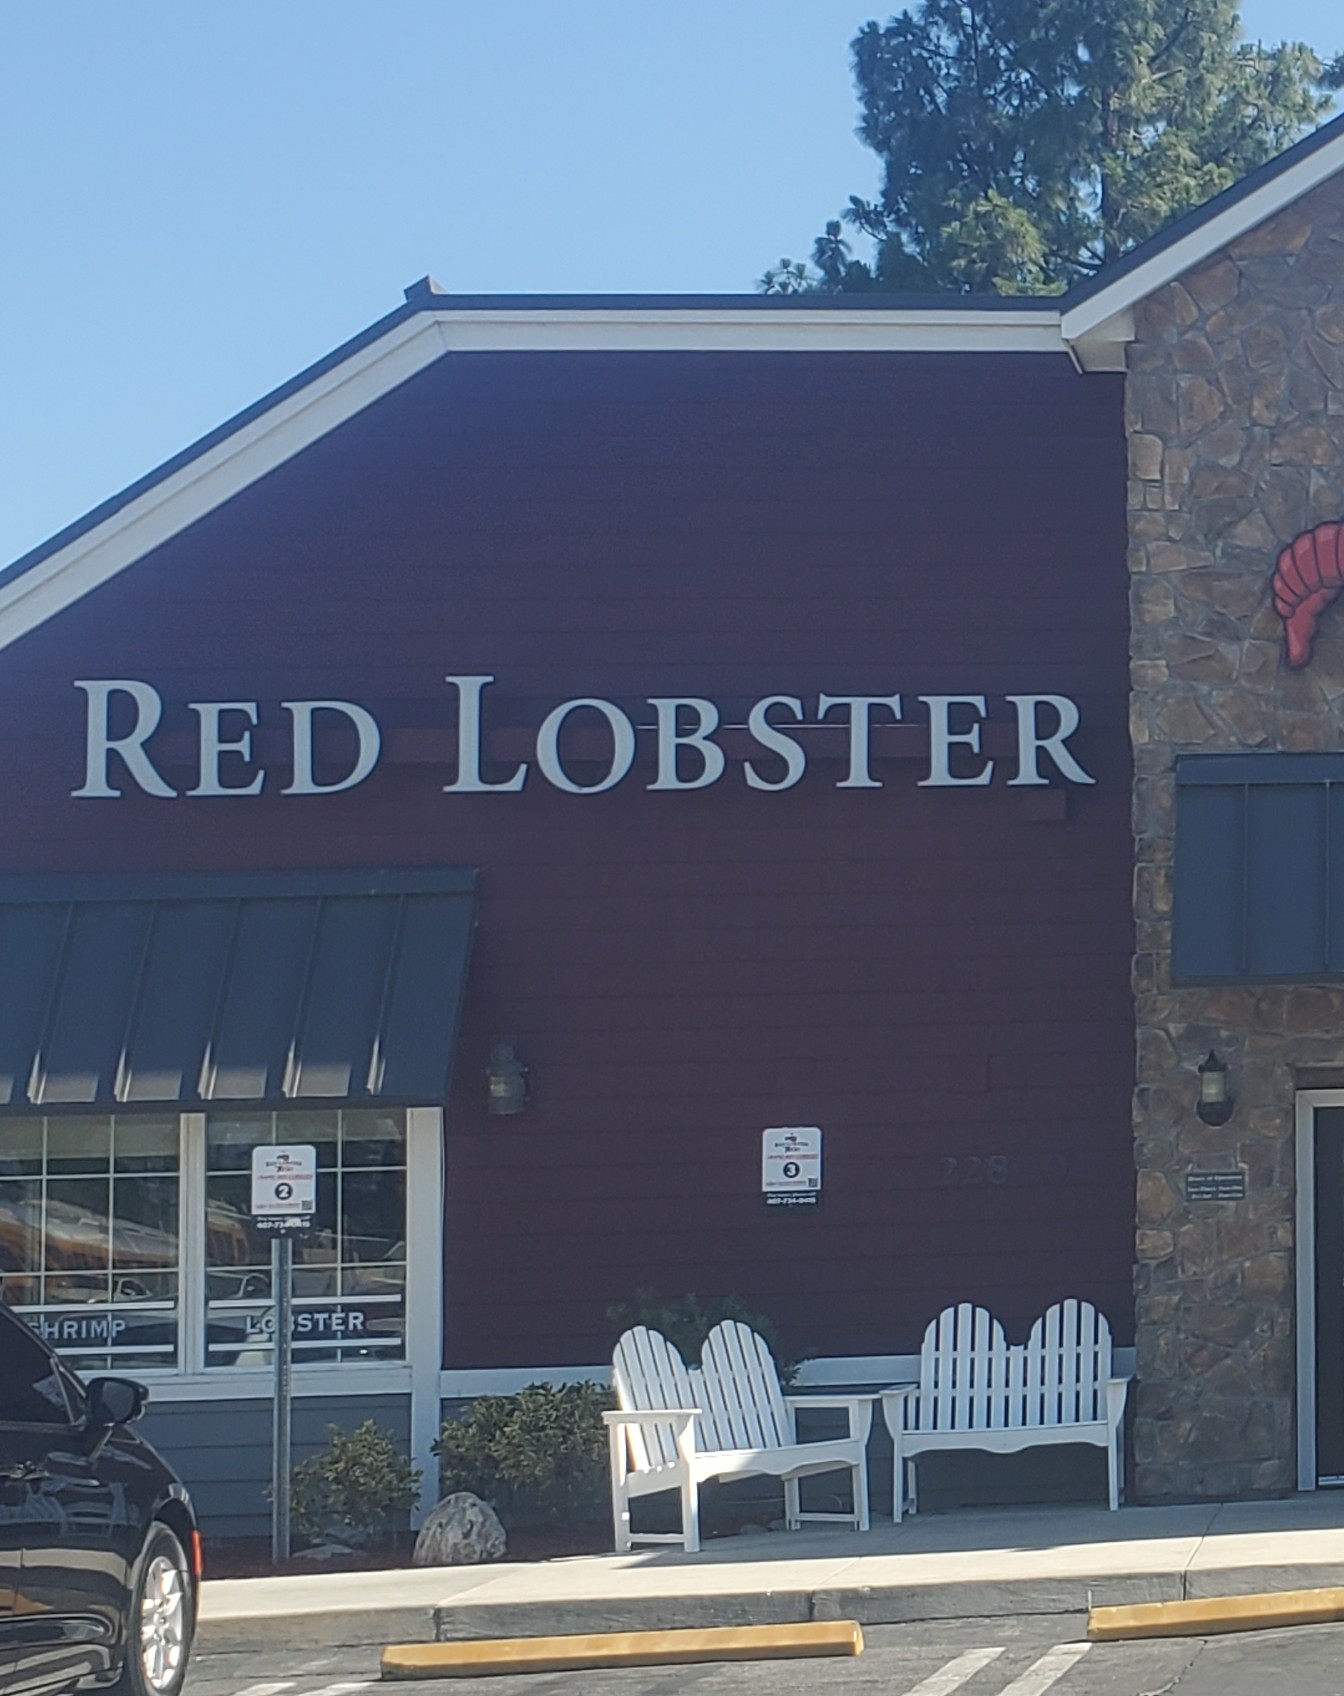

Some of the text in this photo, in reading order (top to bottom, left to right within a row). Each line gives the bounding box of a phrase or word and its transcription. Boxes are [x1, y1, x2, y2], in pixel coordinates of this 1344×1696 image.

[70, 675, 1097, 798] RED LOBSTER
[786, 1164, 797, 1177] 3
[278, 1184, 290, 1198] 2
[246, 1311, 365, 1334] LOSTER
